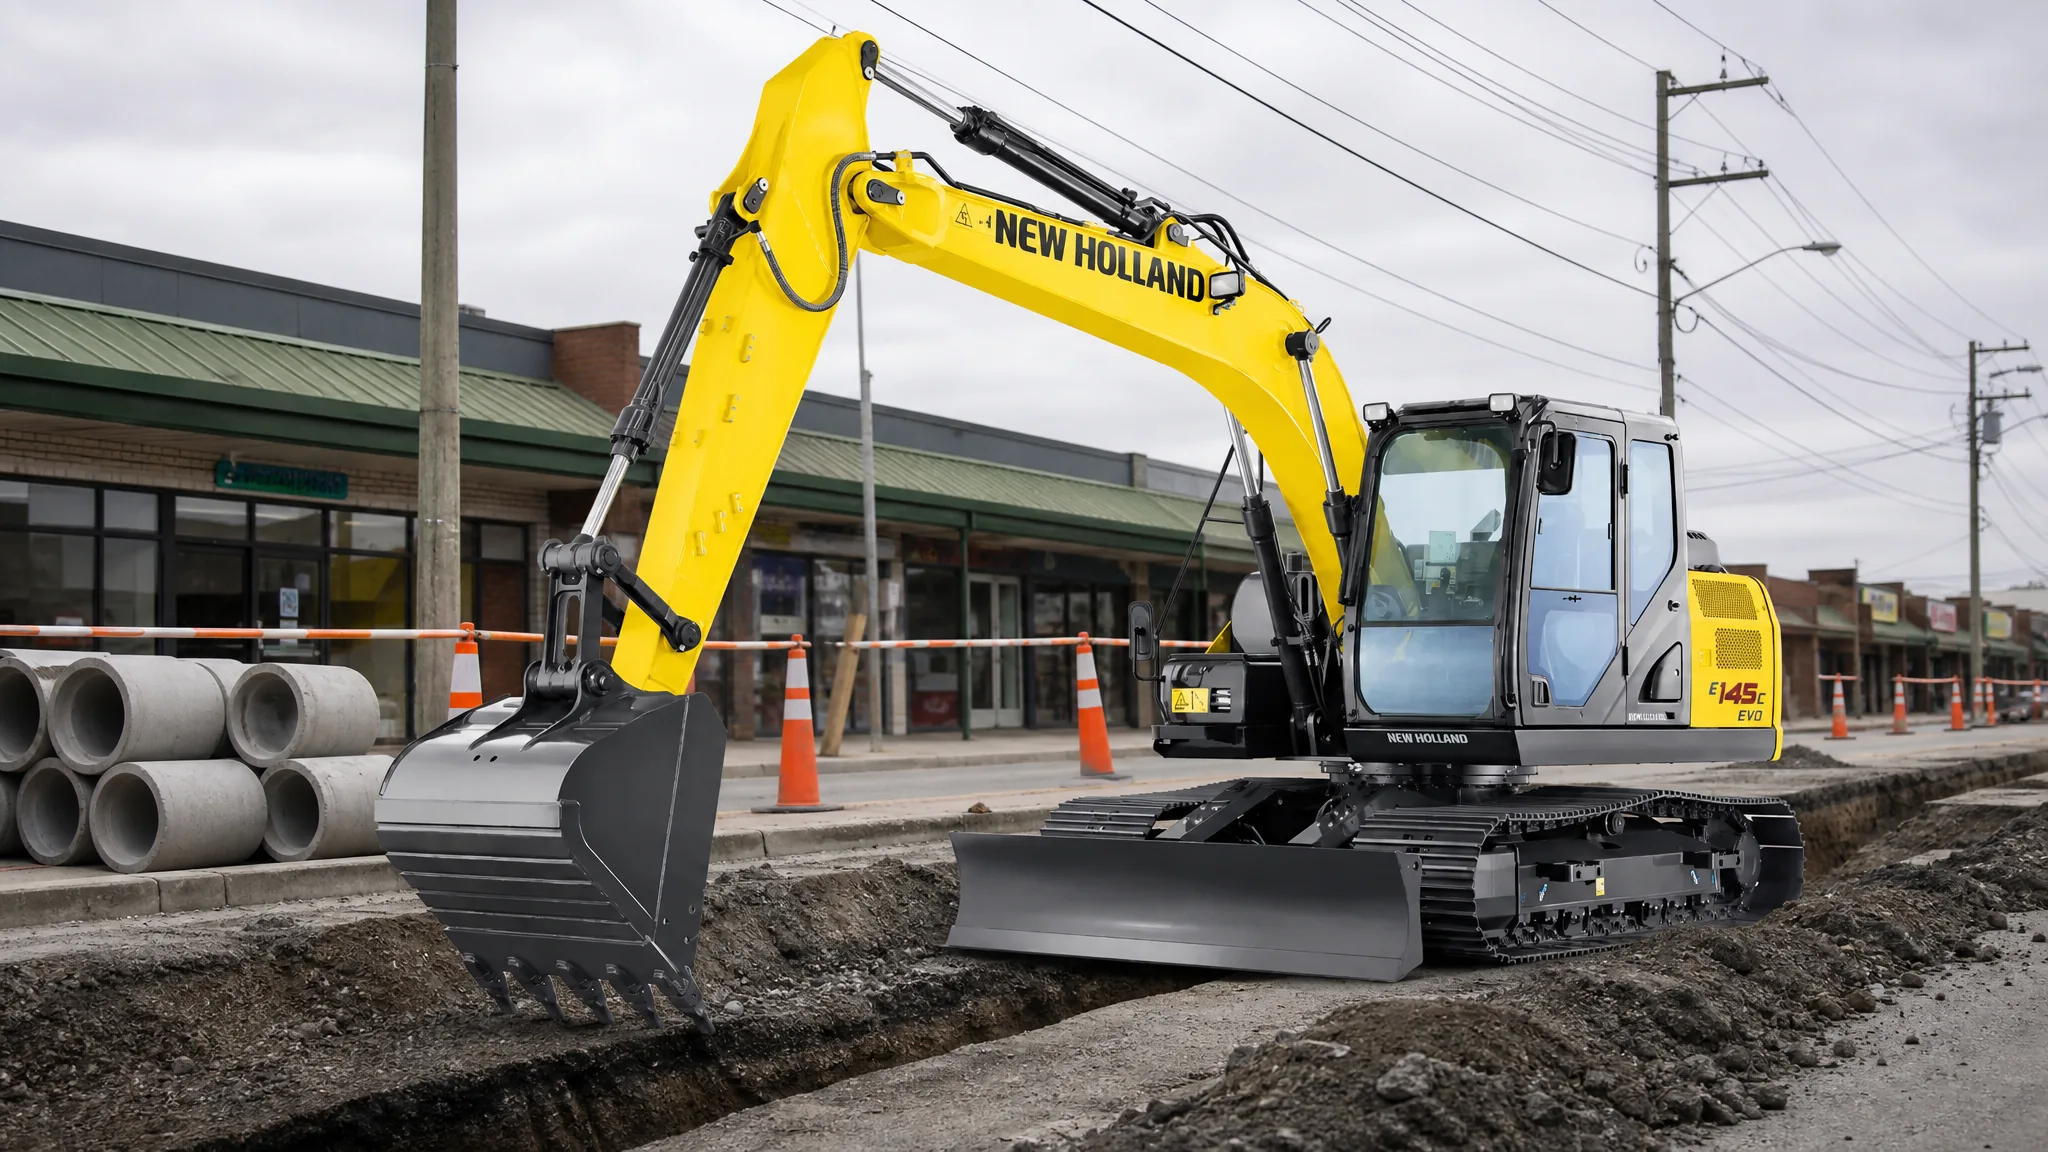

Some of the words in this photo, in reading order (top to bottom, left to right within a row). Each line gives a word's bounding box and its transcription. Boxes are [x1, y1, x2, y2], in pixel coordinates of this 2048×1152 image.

[995, 209, 1067, 262] NEW
[1074, 233, 1205, 303] HOLLAND
[1709, 681, 1766, 705] E145C
[1737, 710, 1763, 721] EVO
[1387, 732, 1413, 743] NEW
[1414, 733, 1469, 744] HOLLAND
